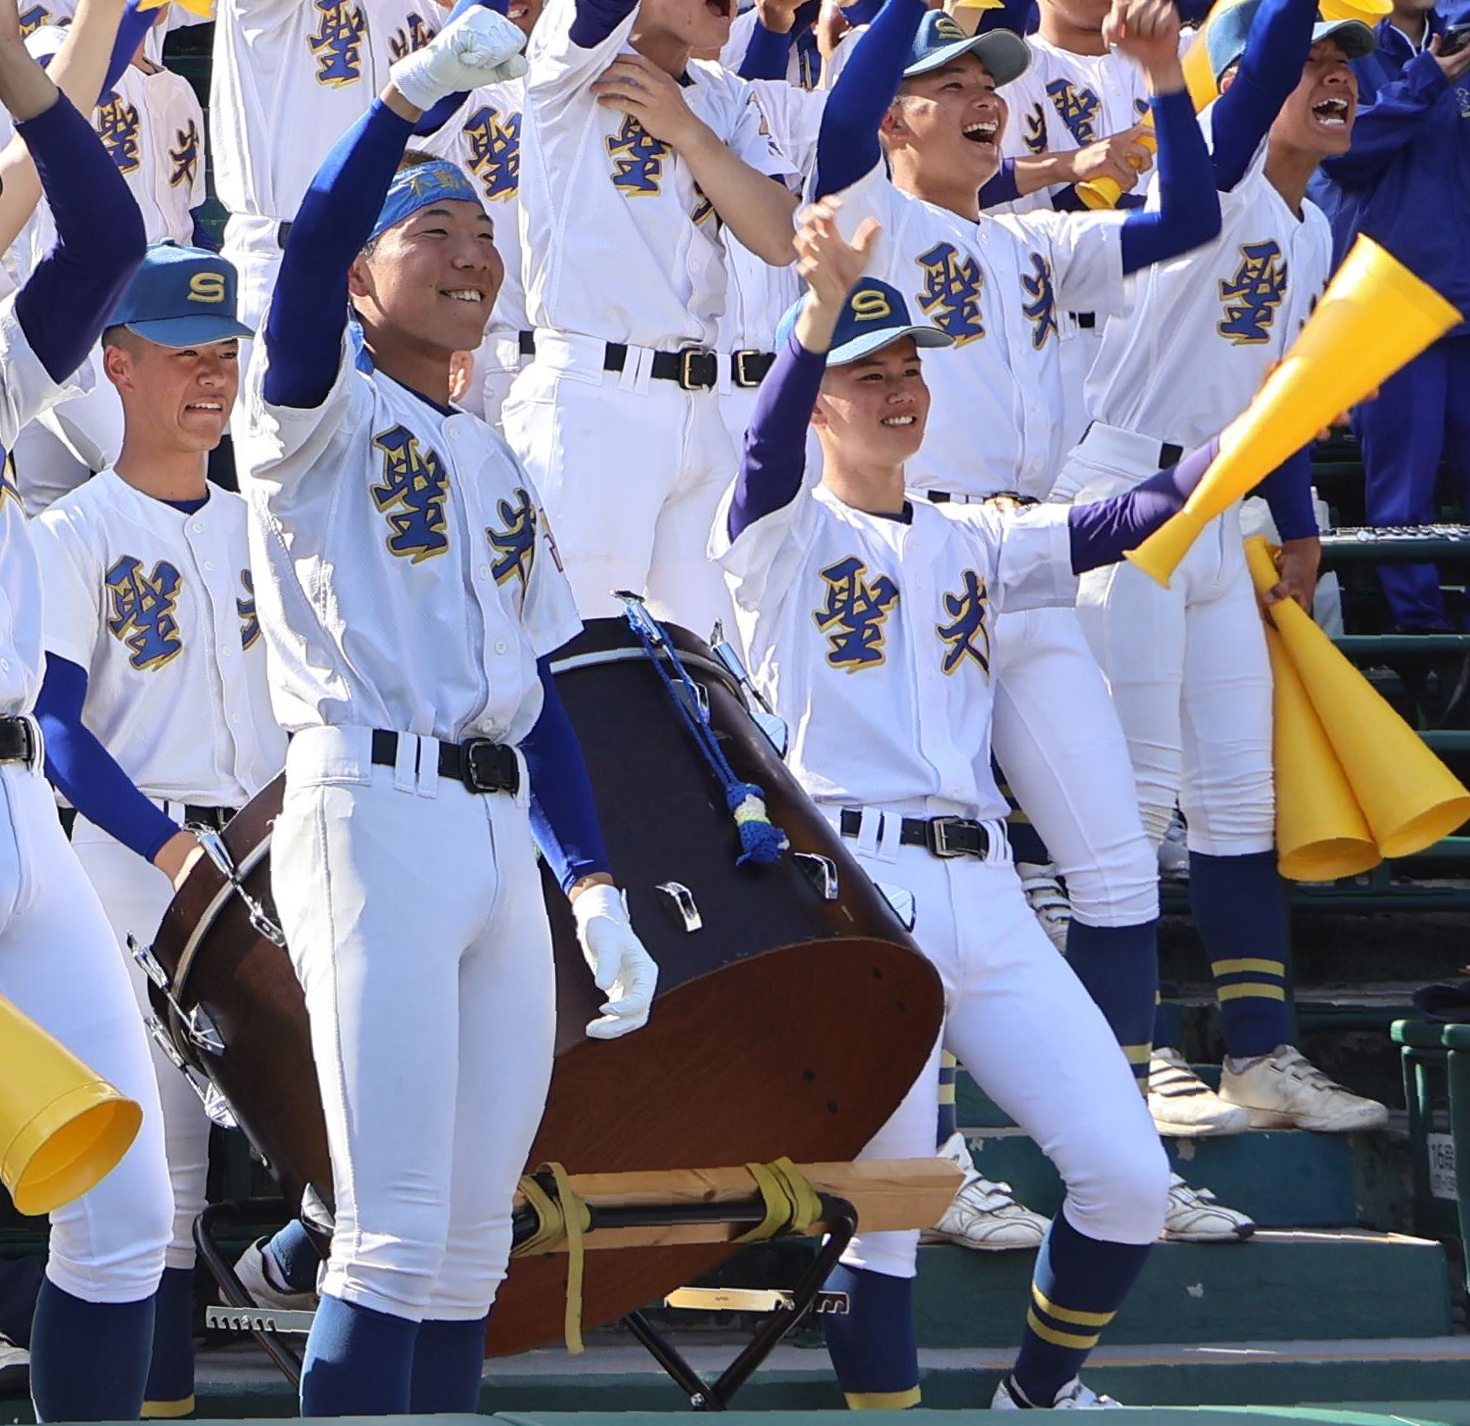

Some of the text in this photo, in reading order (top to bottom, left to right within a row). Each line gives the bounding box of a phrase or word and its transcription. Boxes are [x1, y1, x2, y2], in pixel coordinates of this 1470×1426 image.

[938, 18, 968, 41] S
[187, 273, 226, 305] S
[851, 288, 892, 322] S
